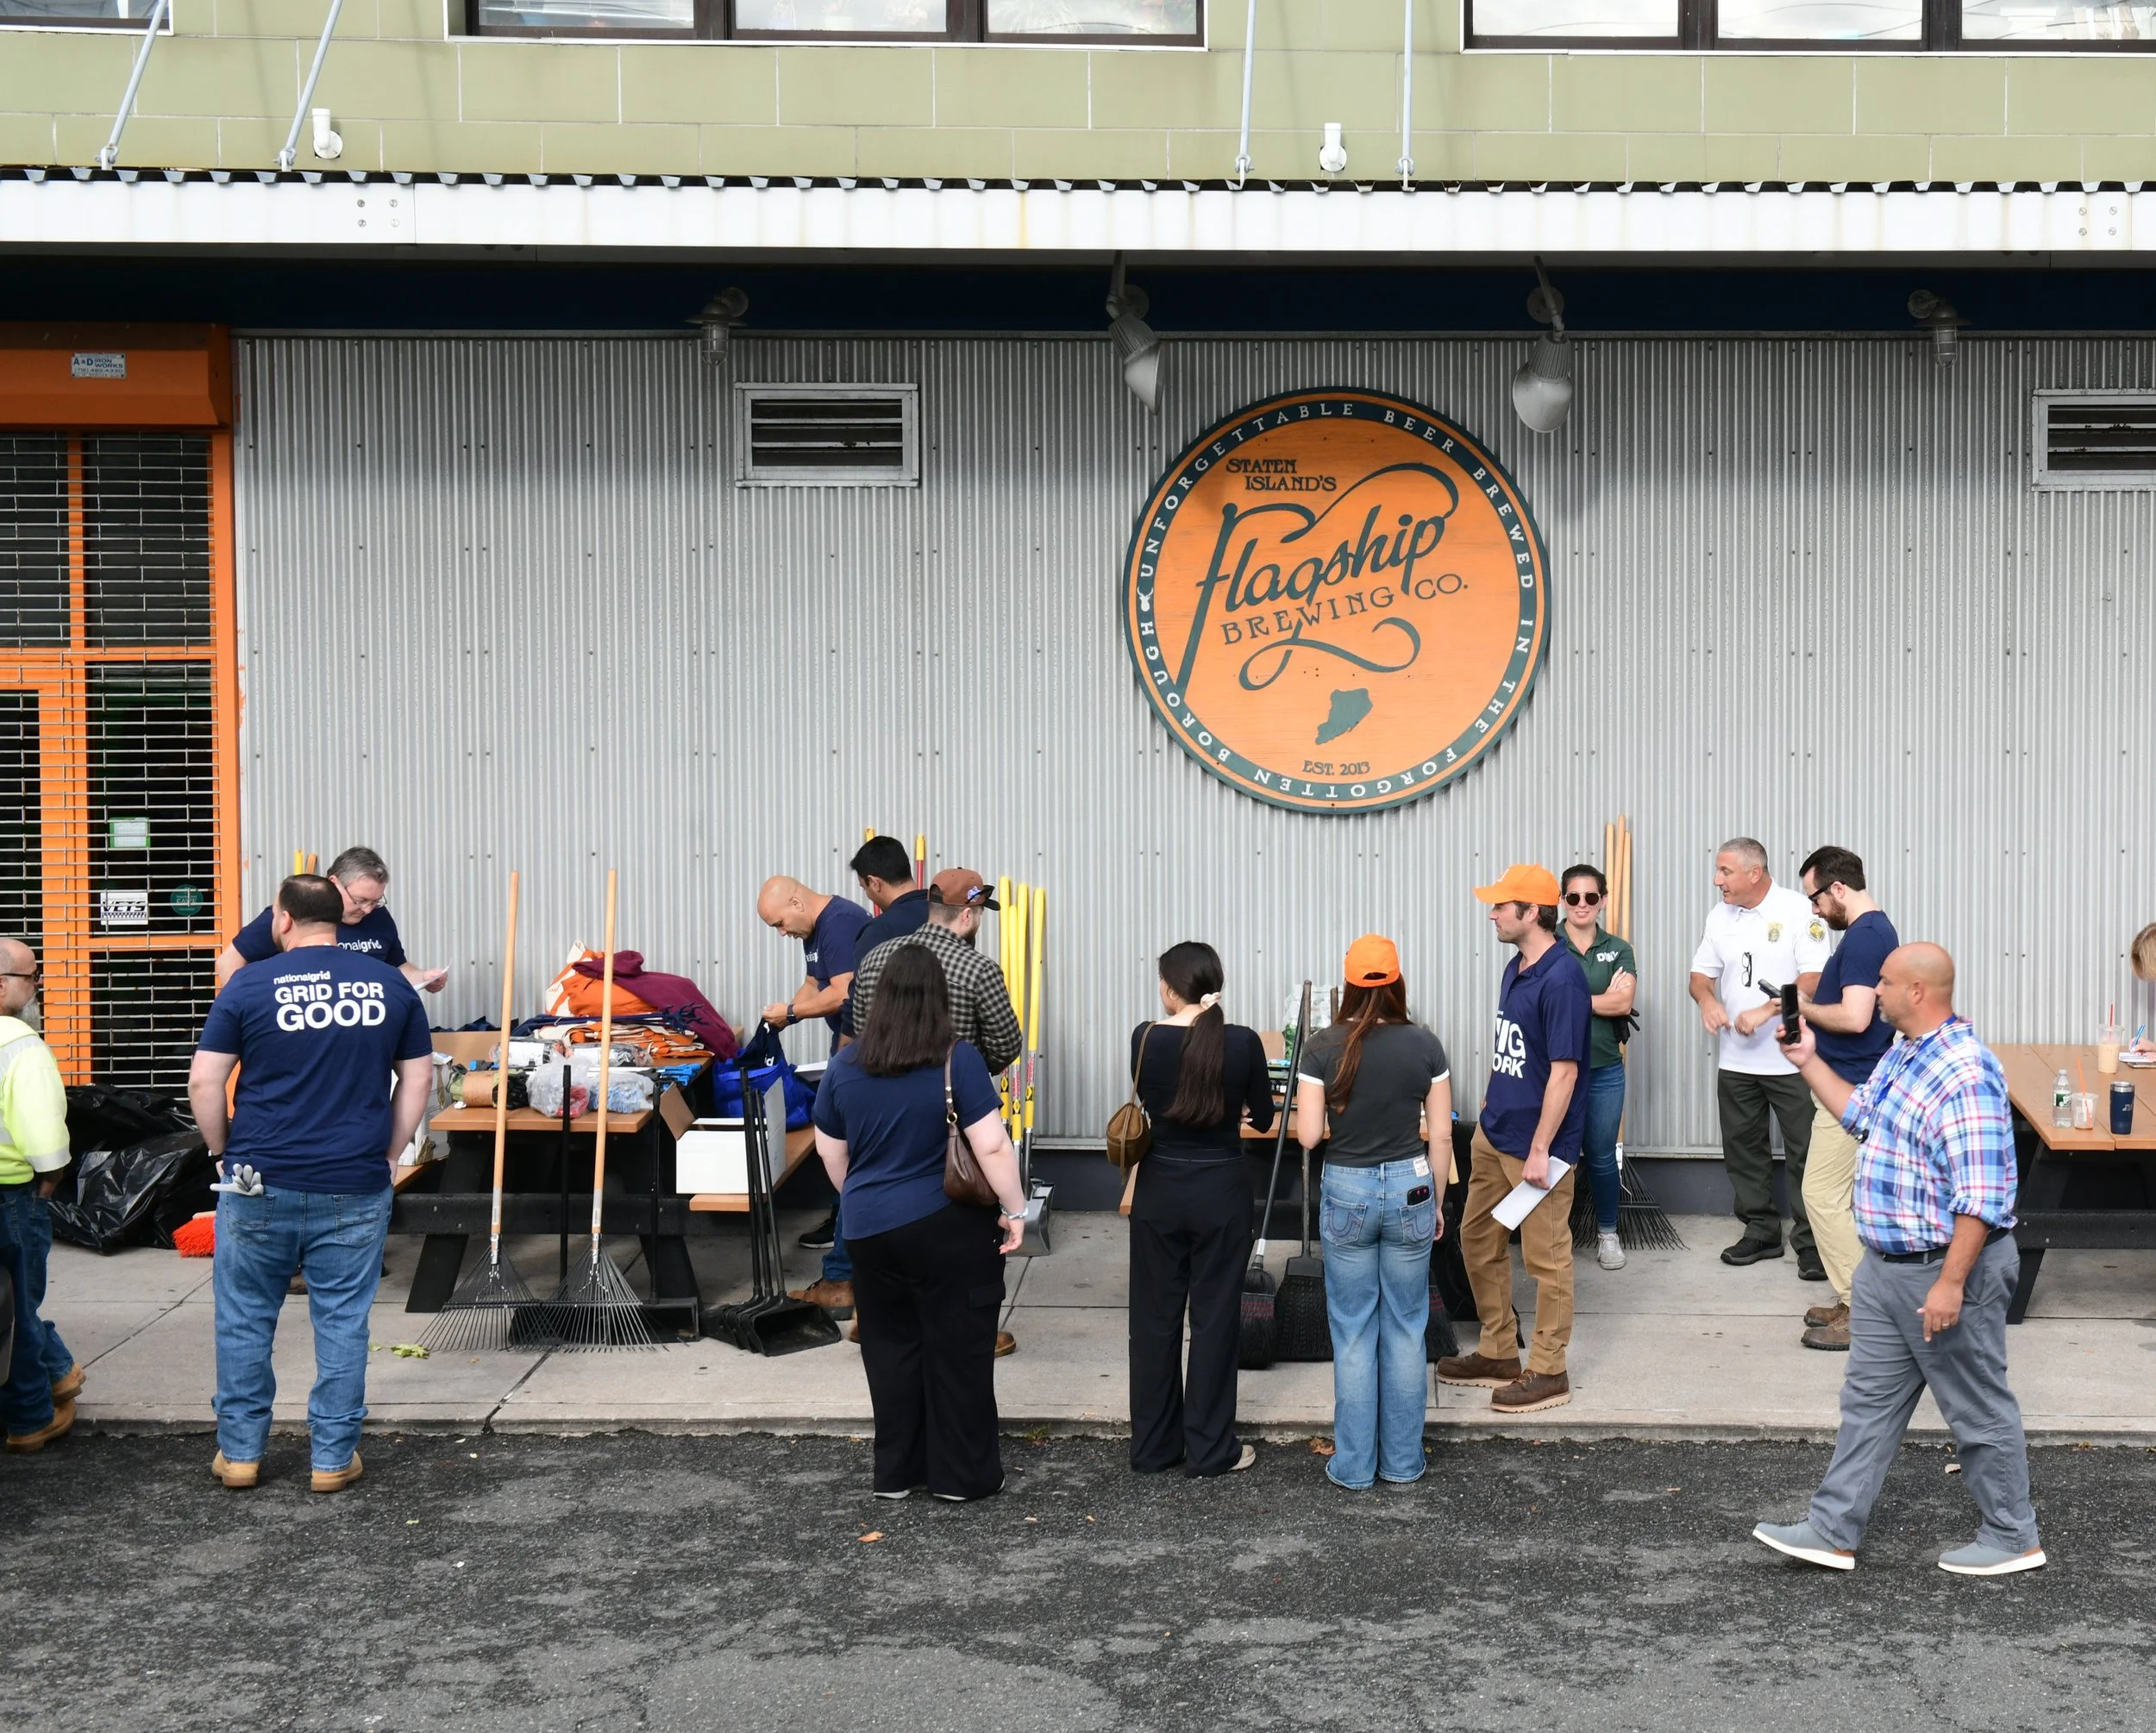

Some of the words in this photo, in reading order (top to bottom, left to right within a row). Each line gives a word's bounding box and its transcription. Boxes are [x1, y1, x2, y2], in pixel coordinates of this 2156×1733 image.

[1384, 410, 1455, 454] BEER
[1225, 459, 1297, 474] STATEN
[1245, 474, 1337, 492] ISLAND'S
[1140, 402, 1353, 578] UNFORGETTABLE
[1473, 466, 1535, 589] BREWED
[1221, 587, 1395, 645] BREWING
[1414, 573, 1469, 600] CO.
[1515, 619, 1535, 653] IN
[1140, 621, 1229, 762] BOROUGH
[1475, 680, 1516, 734] THE
[1254, 749, 1457, 799] FORGOTTEN
[1302, 761, 1335, 775] EST.
[273, 970, 331, 985] nationalgrid
[274, 983, 333, 1004] GRID
[337, 982, 385, 1000] FOR
[276, 999, 386, 1032] GOOD
[1493, 1052, 1526, 1078] ORK
